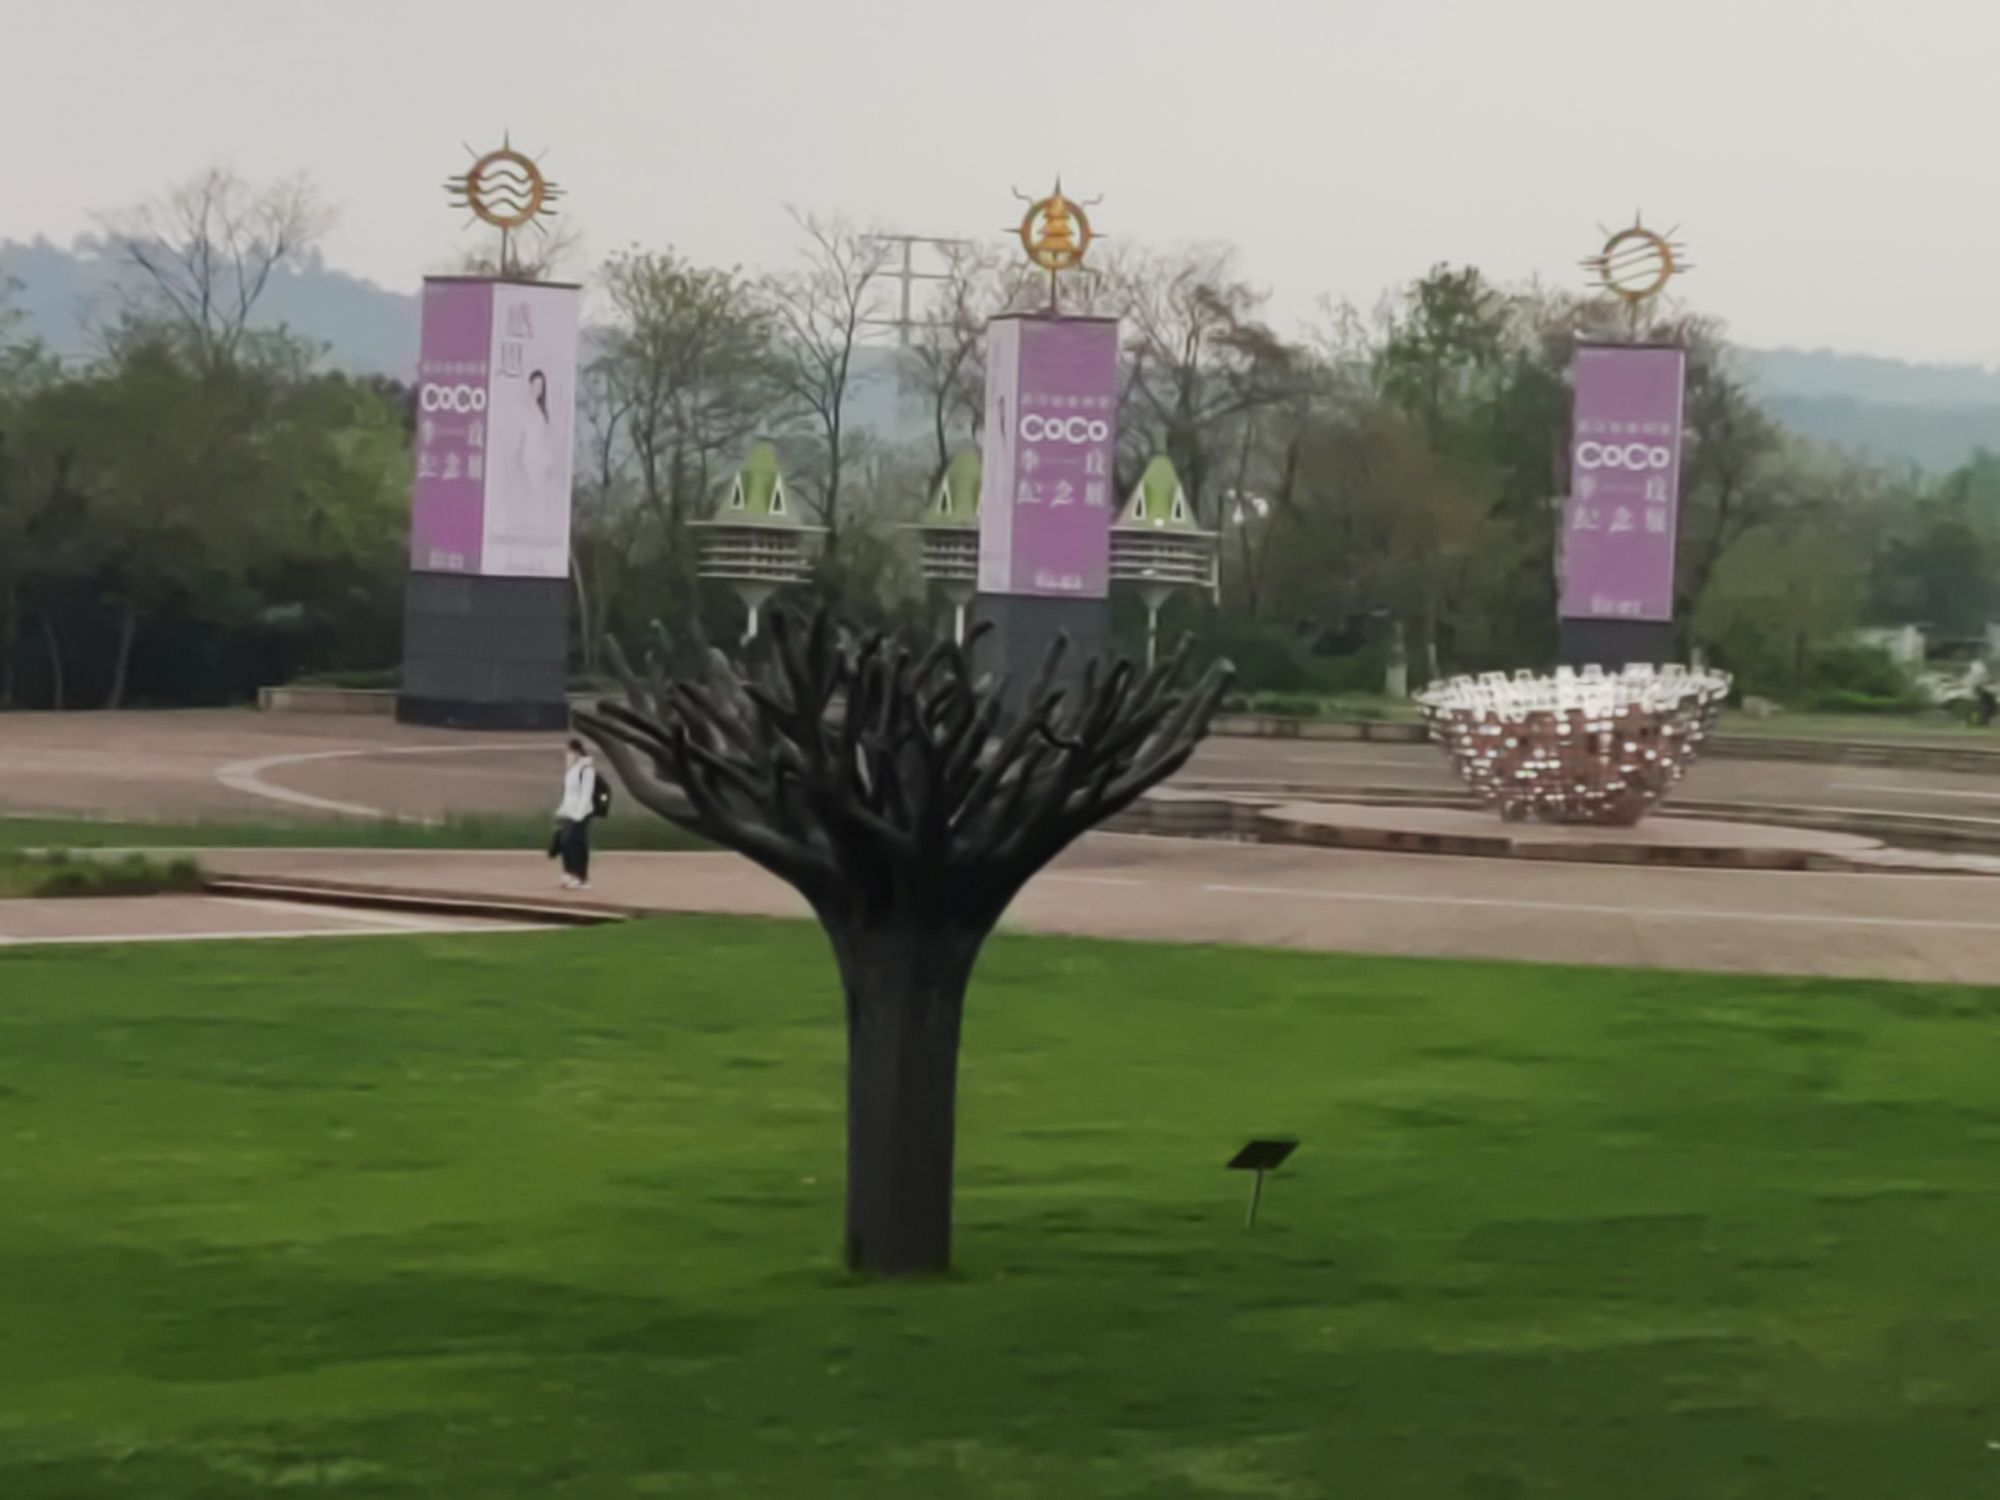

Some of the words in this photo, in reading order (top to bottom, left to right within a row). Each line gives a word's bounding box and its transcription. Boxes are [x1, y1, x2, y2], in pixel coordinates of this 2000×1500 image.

[420, 383, 486, 413] CoCo
[1020, 414, 1108, 444] CoCo
[1576, 441, 1671, 471] CoCo
